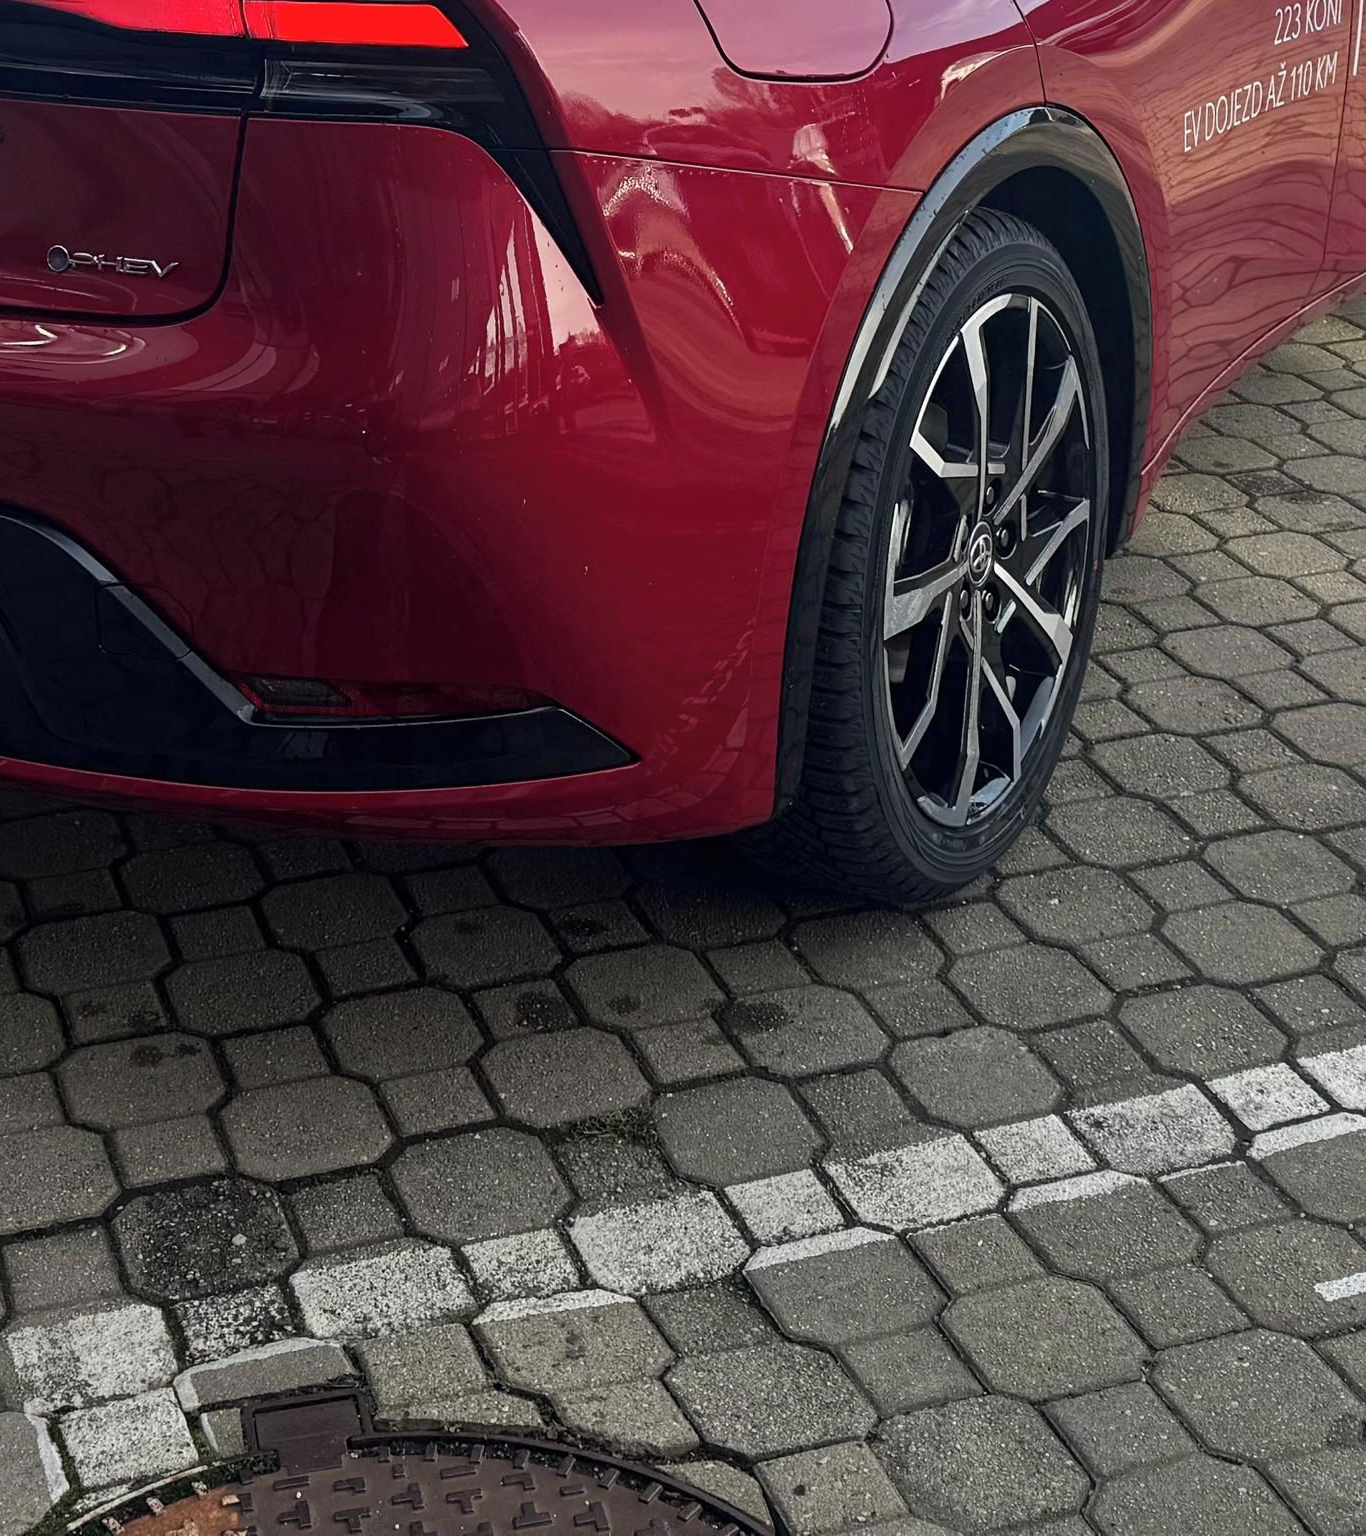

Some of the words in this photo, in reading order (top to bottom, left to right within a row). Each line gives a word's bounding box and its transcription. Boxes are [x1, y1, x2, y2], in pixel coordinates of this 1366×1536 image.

[1274, 3, 1301, 45] 223
[1184, 106, 1202, 152] EV
[1205, 81, 1263, 141] DOJEZD
[1265, 61, 1287, 111] AŽ
[1291, 60, 1313, 101] 110
[1315, 51, 1338, 91] KM
